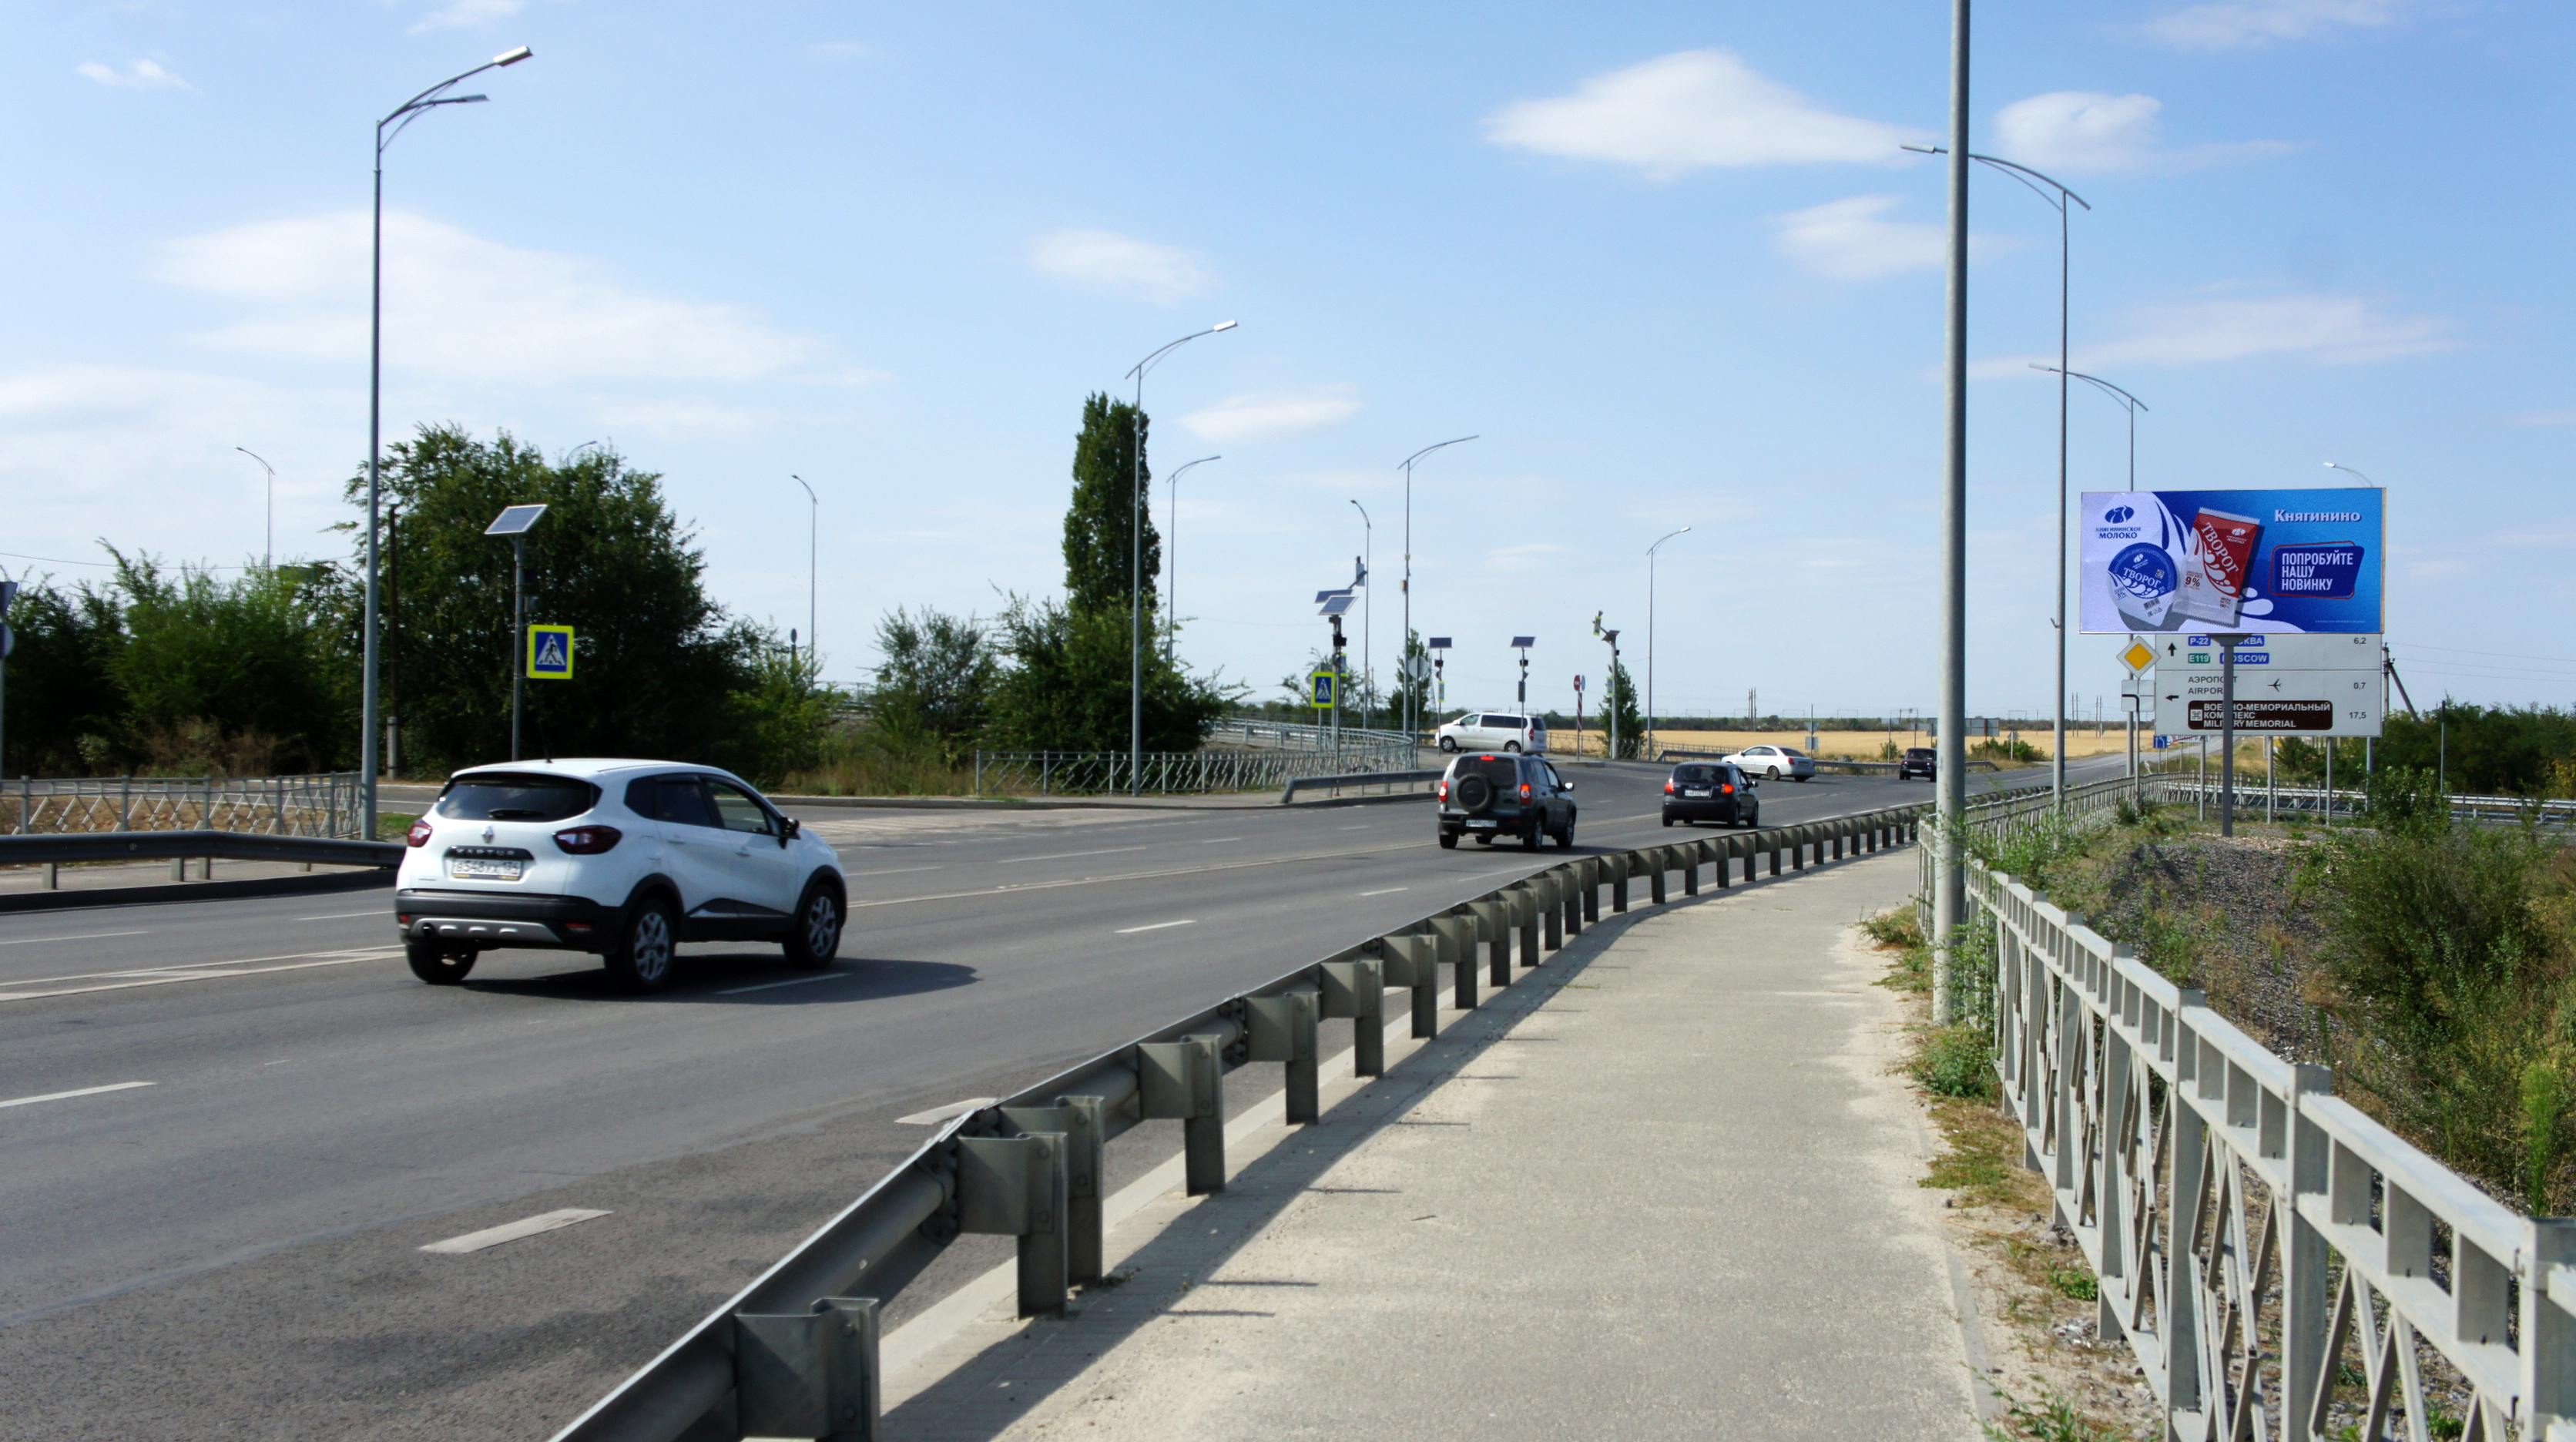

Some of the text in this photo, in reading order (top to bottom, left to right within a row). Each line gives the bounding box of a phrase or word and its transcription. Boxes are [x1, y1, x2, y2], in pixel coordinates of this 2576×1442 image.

[2274, 509, 2362, 522] Княгинино
[2200, 521, 2239, 573] ТВОРОГ
[2282, 549, 2354, 565] ПОПРОБУЙТЕ
[2282, 565, 2315, 578] НАШУ
[2123, 567, 2162, 588] ТВОРОГ
[2185, 576, 2201, 587] 9%
[2281, 578, 2333, 591] НОВИНКУ
[2353, 637, 2366, 646] 6,2
[2353, 682, 2366, 690] 0,7
[2203, 702, 2330, 711] ВОЕО-МЕМОРИАЛЬНЫЙ
[2203, 711, 2256, 719] КОМЕКС
[2349, 712, 2366, 720] 17,5
[2203, 719, 2296, 728] MILIRY MEMORIAL
